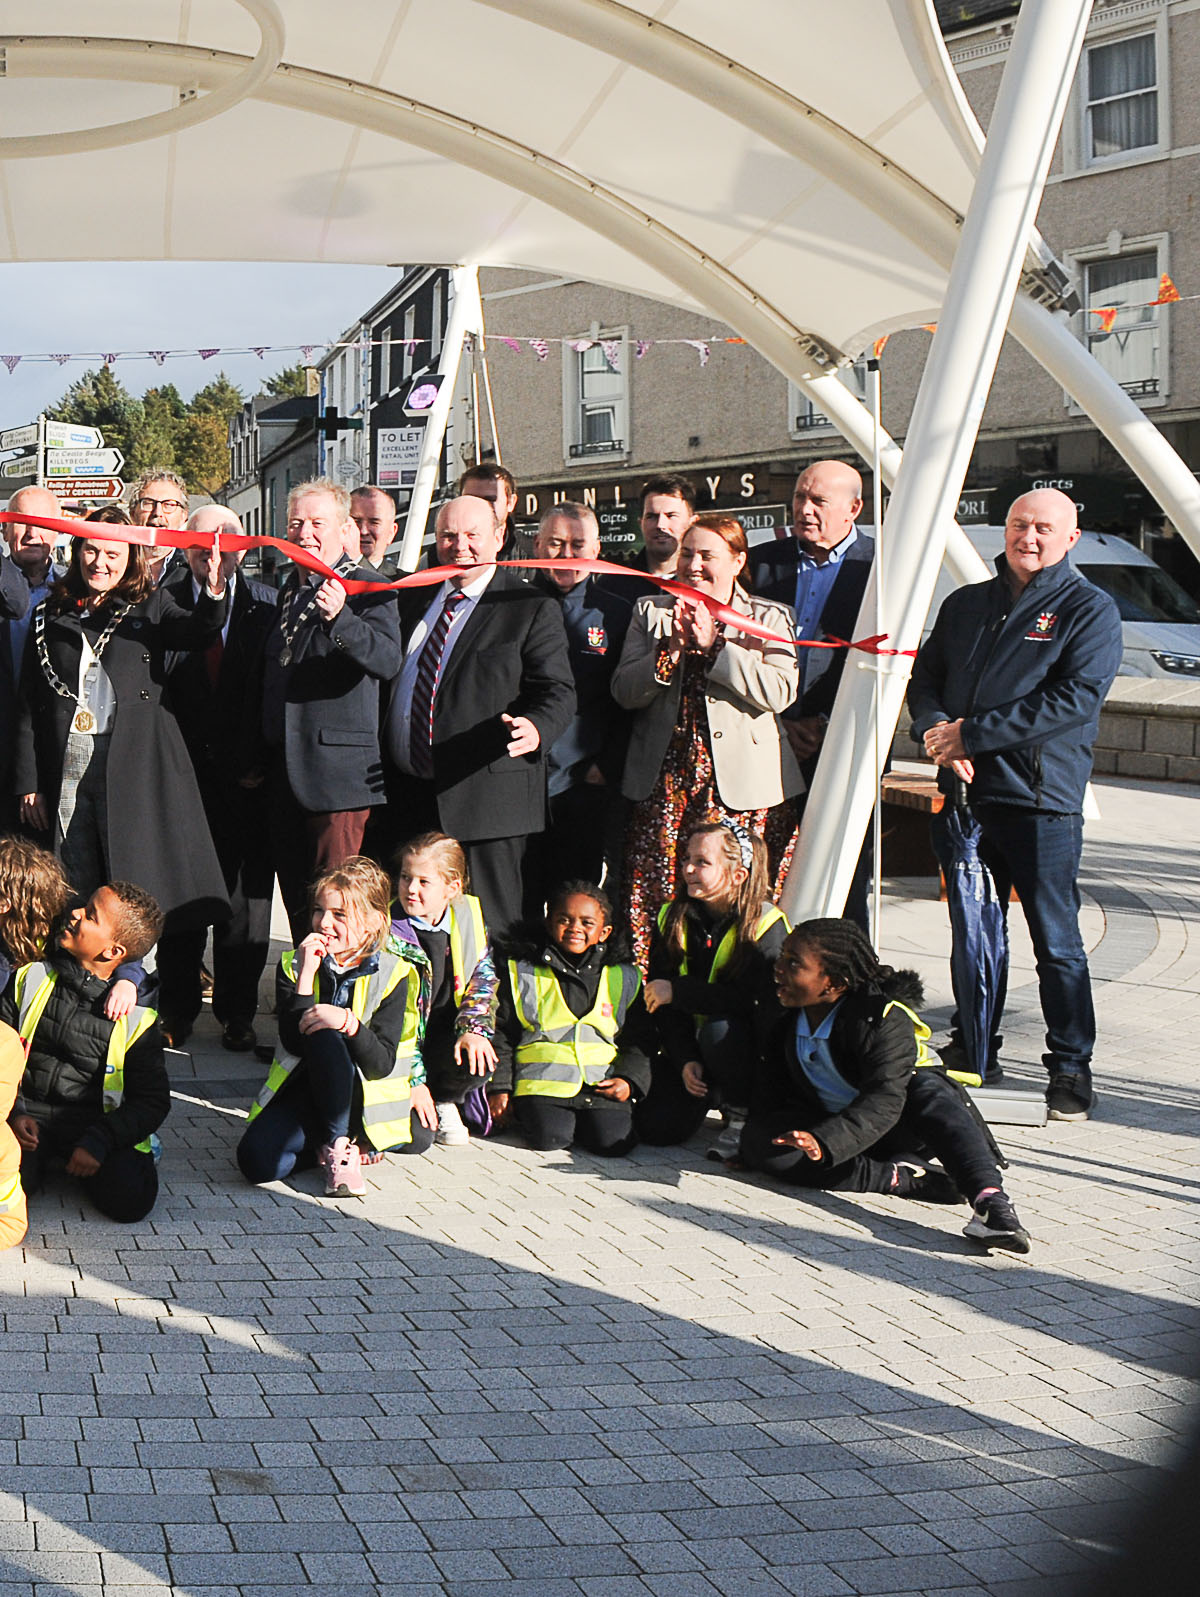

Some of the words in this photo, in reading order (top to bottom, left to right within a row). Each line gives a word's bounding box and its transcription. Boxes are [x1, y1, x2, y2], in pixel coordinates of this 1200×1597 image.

[381, 433, 397, 443] TO
[400, 432, 421, 442] LET
[526, 473, 755, 515] DUNLYS
[957, 500, 989, 516] ORL
[742, 514, 775, 529] ORLD
